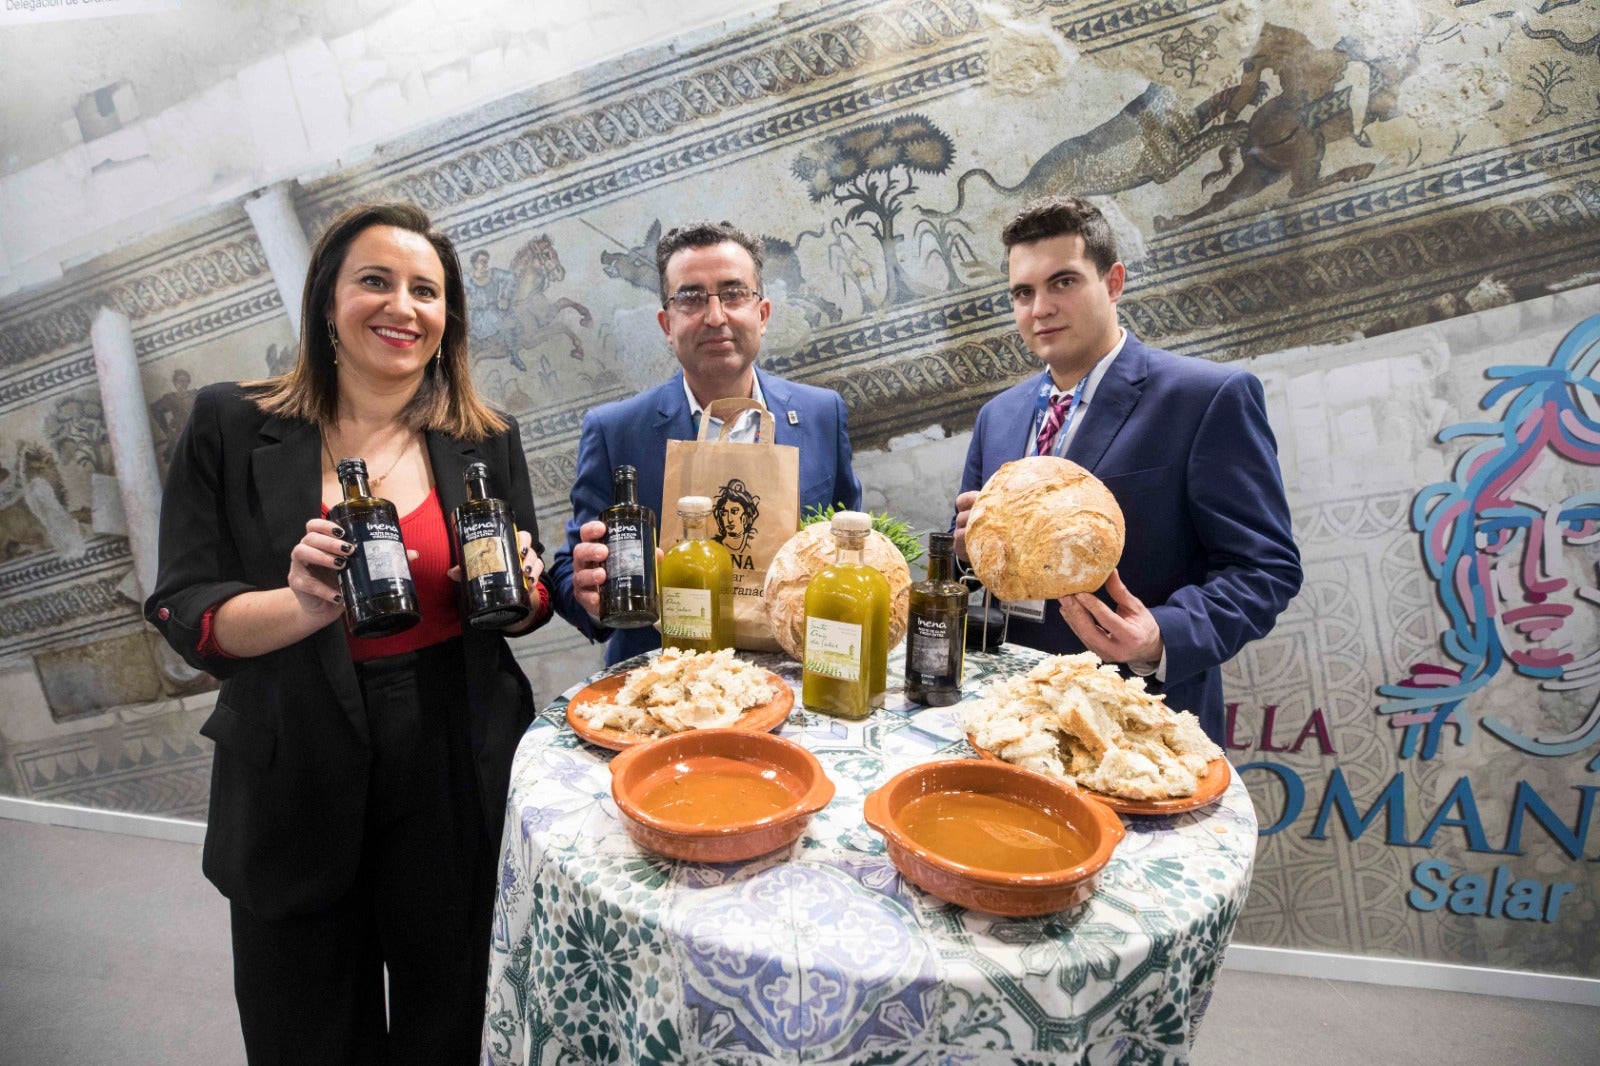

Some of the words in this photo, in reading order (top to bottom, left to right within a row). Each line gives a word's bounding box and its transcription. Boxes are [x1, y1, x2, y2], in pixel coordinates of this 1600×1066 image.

[731, 554, 755, 570] NA
[733, 573, 745, 582] ar
[1224, 702, 1338, 755] LLA
[1236, 761, 1600, 863] OMAN
[1408, 858, 1575, 924] Salar
